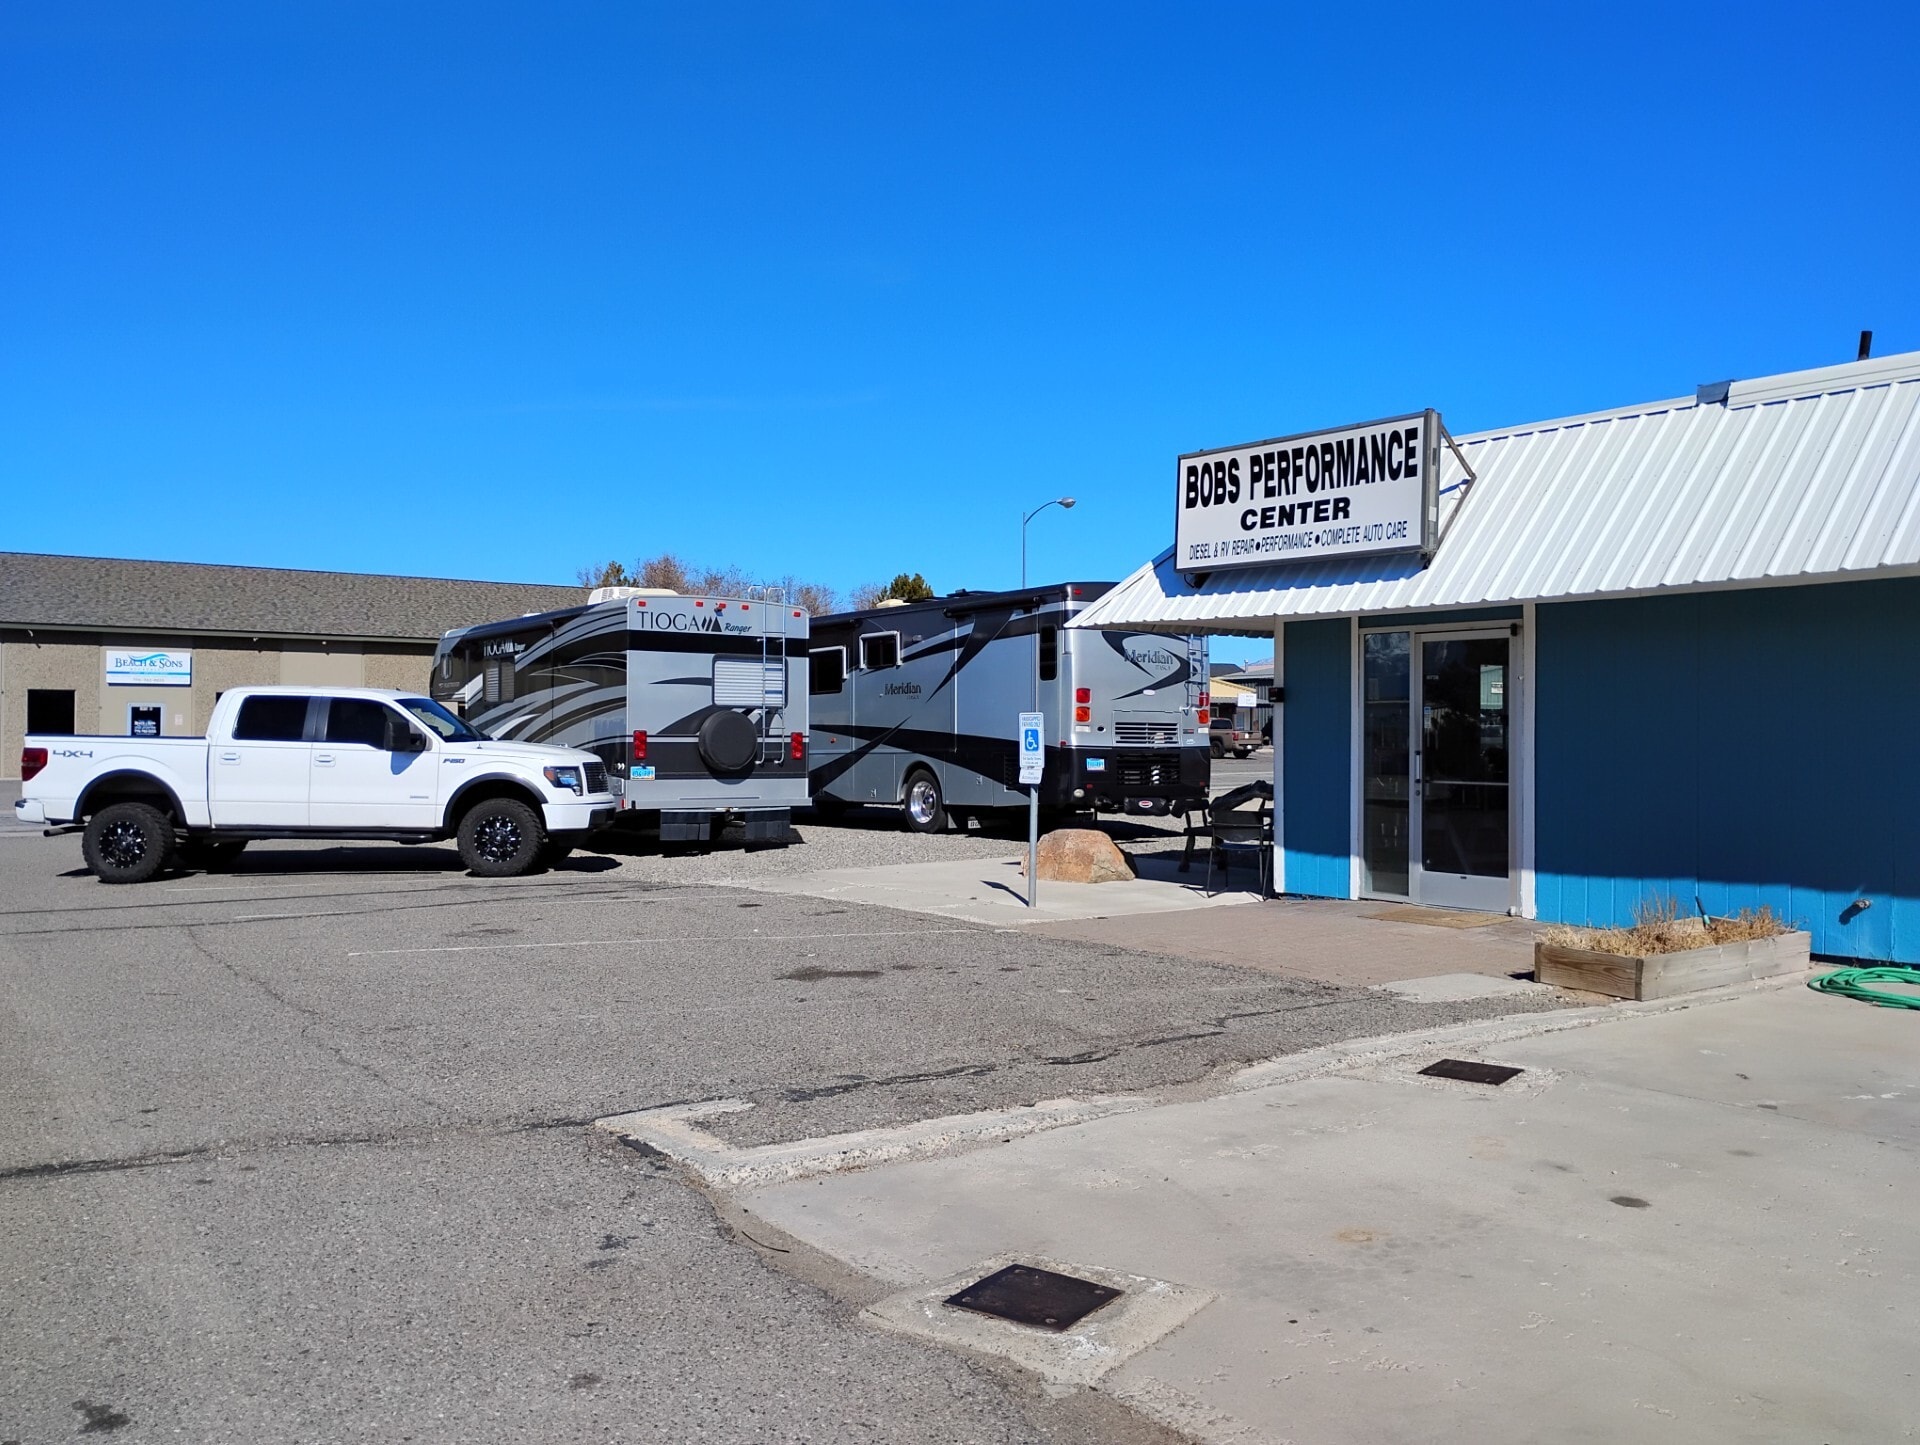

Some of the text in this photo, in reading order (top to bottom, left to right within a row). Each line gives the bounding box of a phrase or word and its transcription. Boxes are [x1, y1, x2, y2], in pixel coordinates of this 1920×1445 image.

[1185, 427, 1419, 509] BOBS PERFORMANCE
[1240, 497, 1351, 531] CENTER
[1189, 520, 1408, 560] DIESEL & RV REPAIR PERFORMANCE COMPLETE AUTO CARE
[637, 610, 752, 634] TIOGA Ranger
[1124, 649, 1174, 665] Meridian
[884, 681, 922, 695] Meridian
